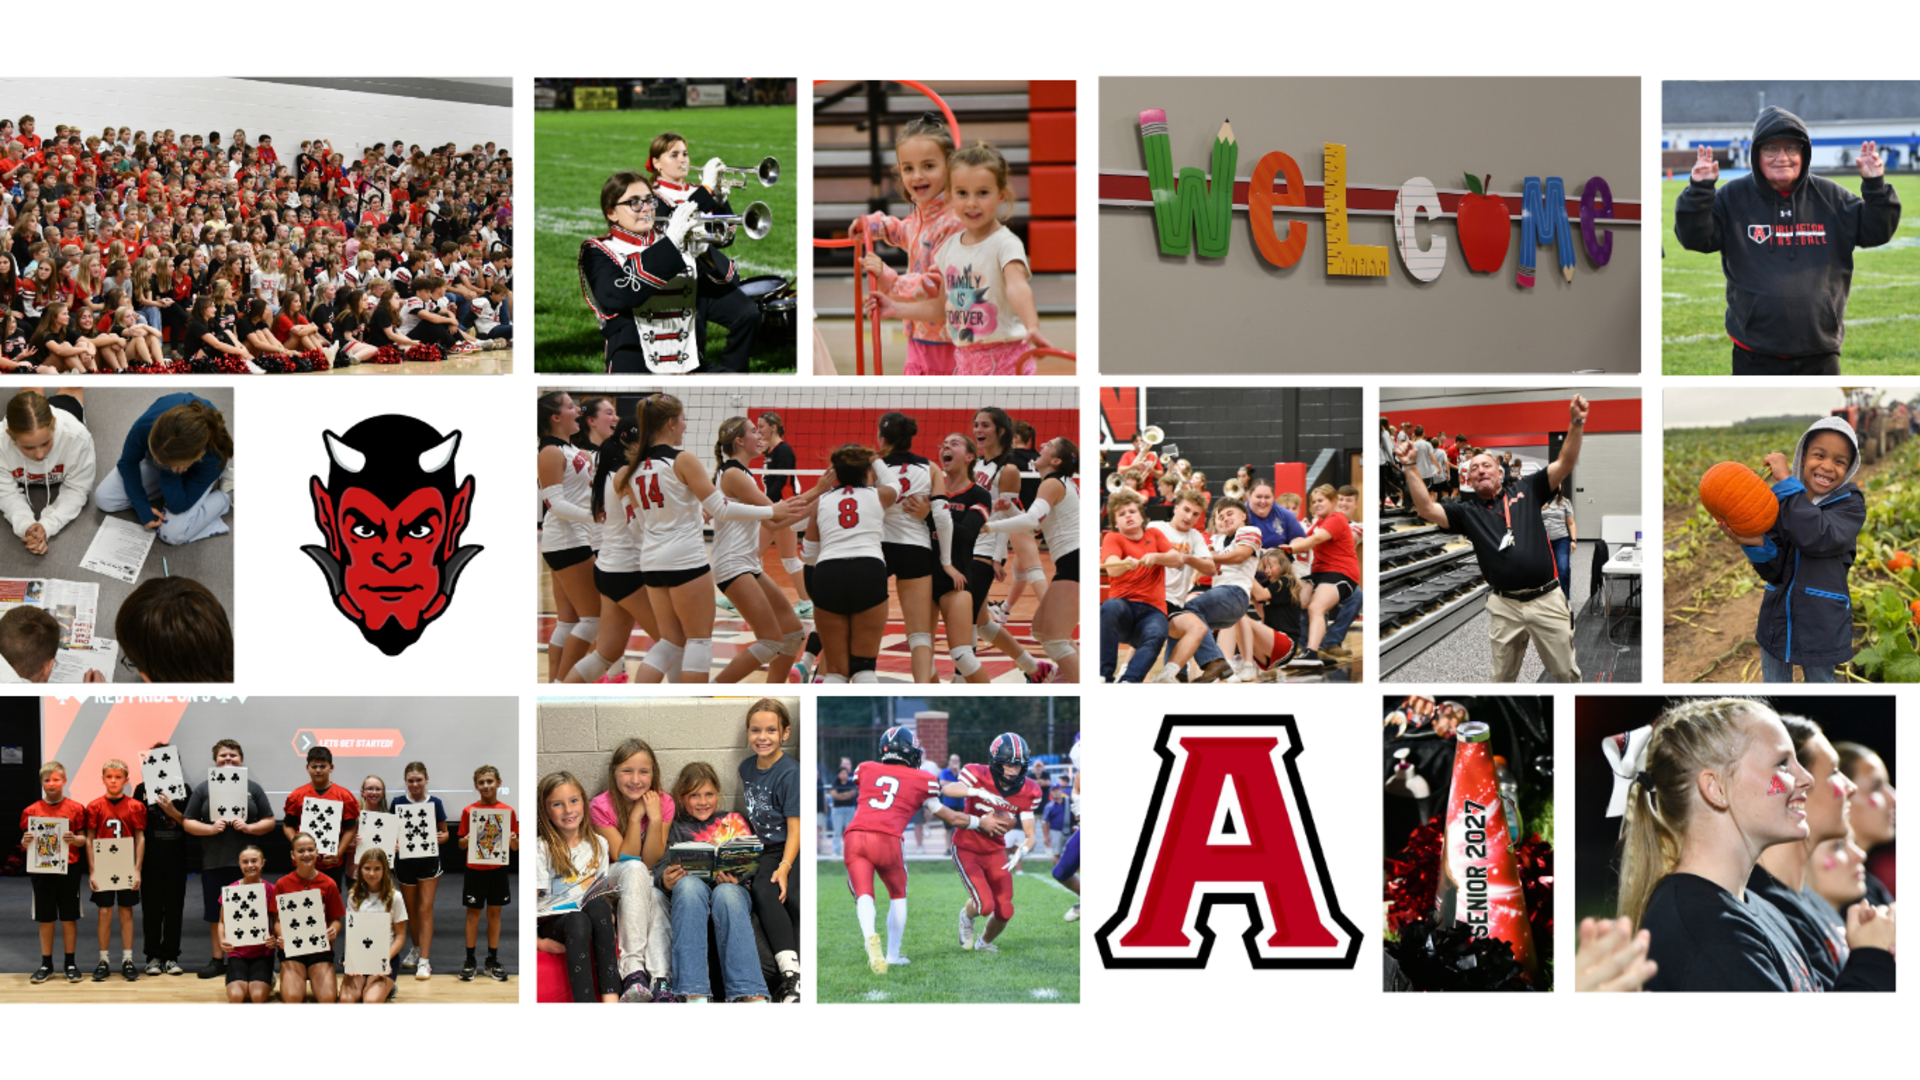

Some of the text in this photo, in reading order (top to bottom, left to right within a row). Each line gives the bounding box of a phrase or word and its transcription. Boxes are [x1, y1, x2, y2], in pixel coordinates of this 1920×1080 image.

[957, 292, 965, 307] IS
[643, 457, 652, 470] A
[635, 473, 664, 510] 14
[838, 497, 859, 529] 8
[340, 739, 354, 748] GET
[868, 775, 900, 811] 3
[1768, 775, 1787, 795] A
[106, 818, 122, 839] 3
[1094, 714, 1365, 970] A
[1464, 800, 1489, 939] SENIOR 2027
